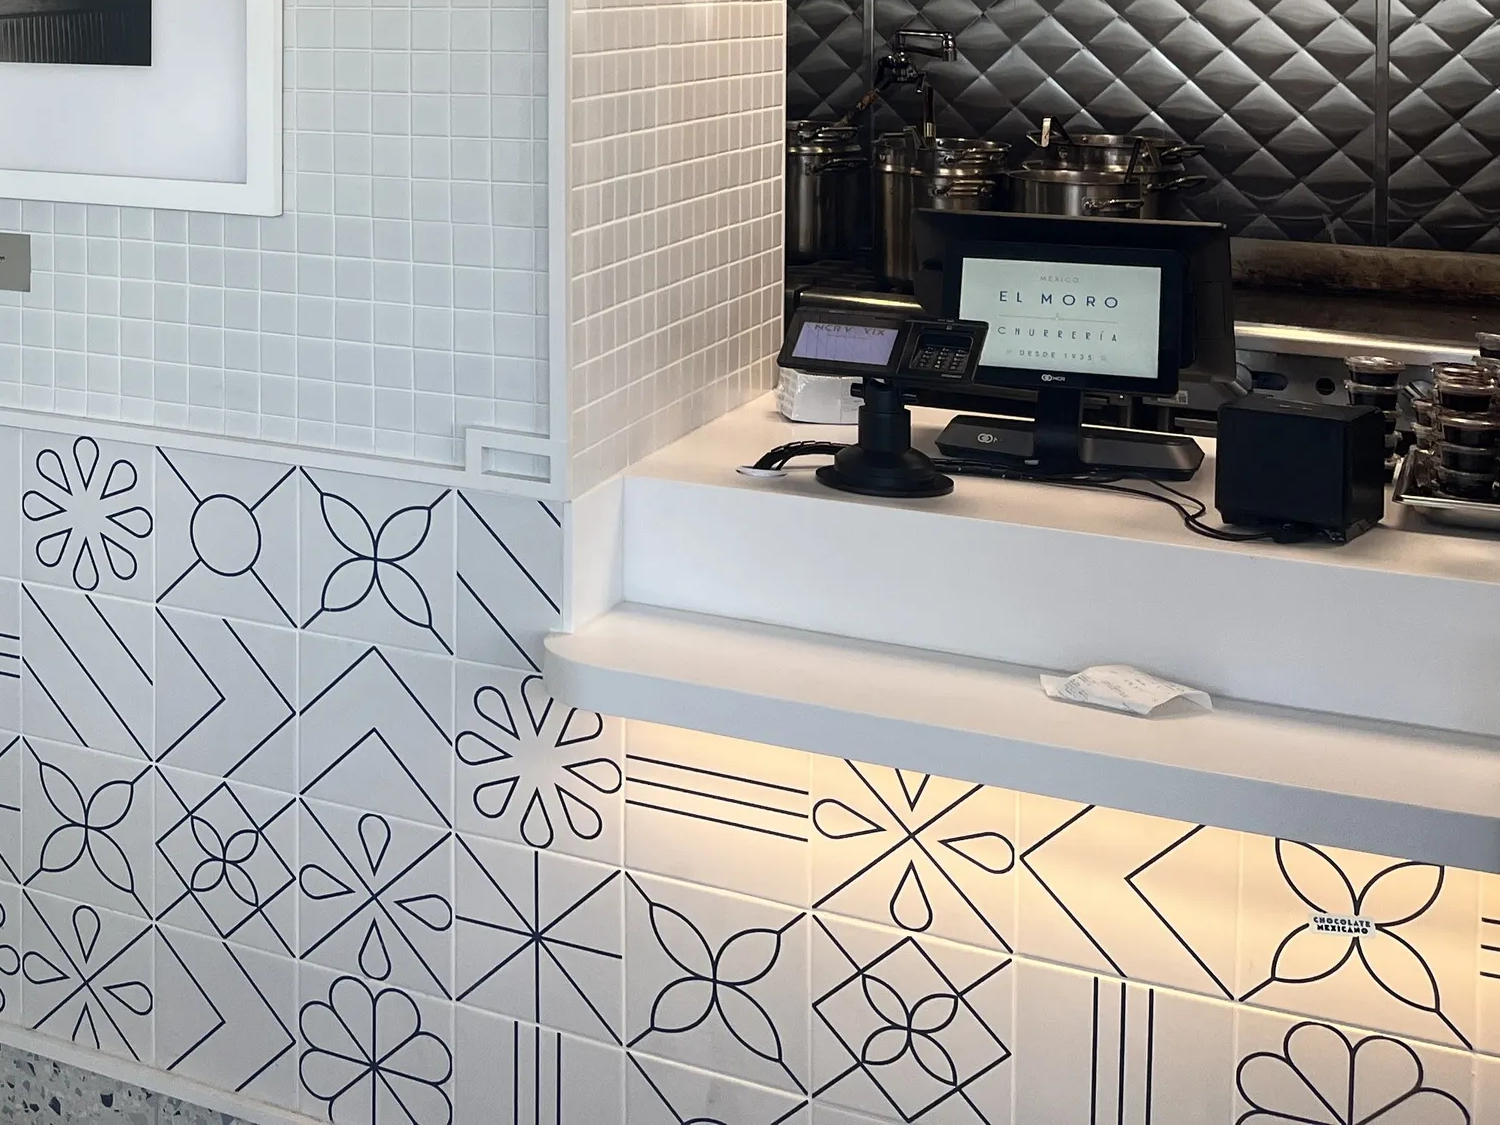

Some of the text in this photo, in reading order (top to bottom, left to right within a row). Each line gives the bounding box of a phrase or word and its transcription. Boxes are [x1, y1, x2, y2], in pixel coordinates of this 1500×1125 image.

[999, 290, 1119, 308] EL MORO
[997, 325, 1118, 342] CHURRERÍA
[1019, 349, 1093, 361] DESDE 1935
[1313, 917, 1371, 927] CHOCOLATE
[1317, 924, 1368, 934] MEXICANO
